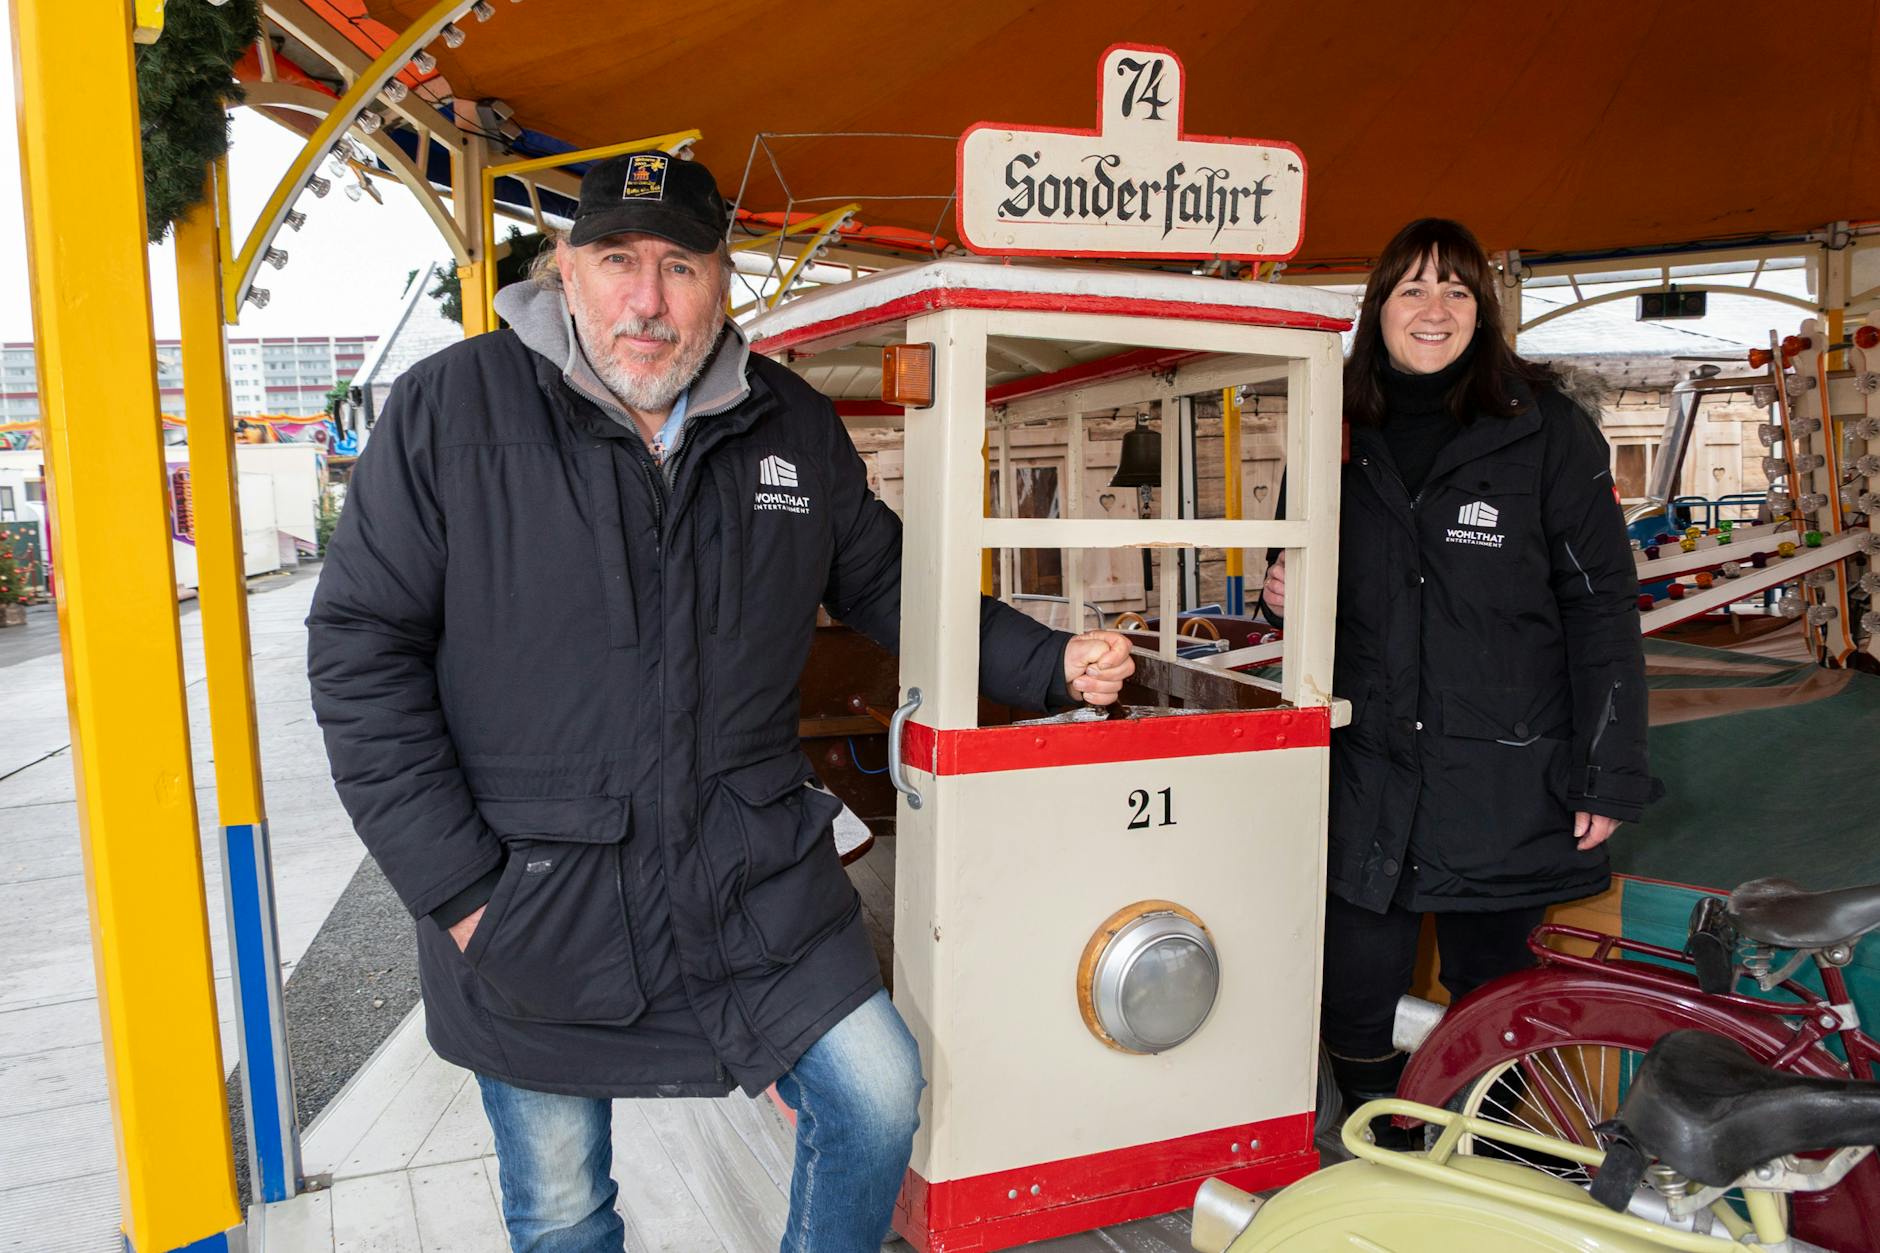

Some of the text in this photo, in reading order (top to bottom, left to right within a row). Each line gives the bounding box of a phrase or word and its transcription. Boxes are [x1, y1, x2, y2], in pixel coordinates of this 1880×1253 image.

[1117, 57, 1174, 121] 74
[998, 151, 1273, 245] Sonderfahrt
[1445, 537, 1503, 549] ENTERTAINMENT
[1447, 528, 1505, 543] WOHLTHAT
[1127, 786, 1178, 830] 21
